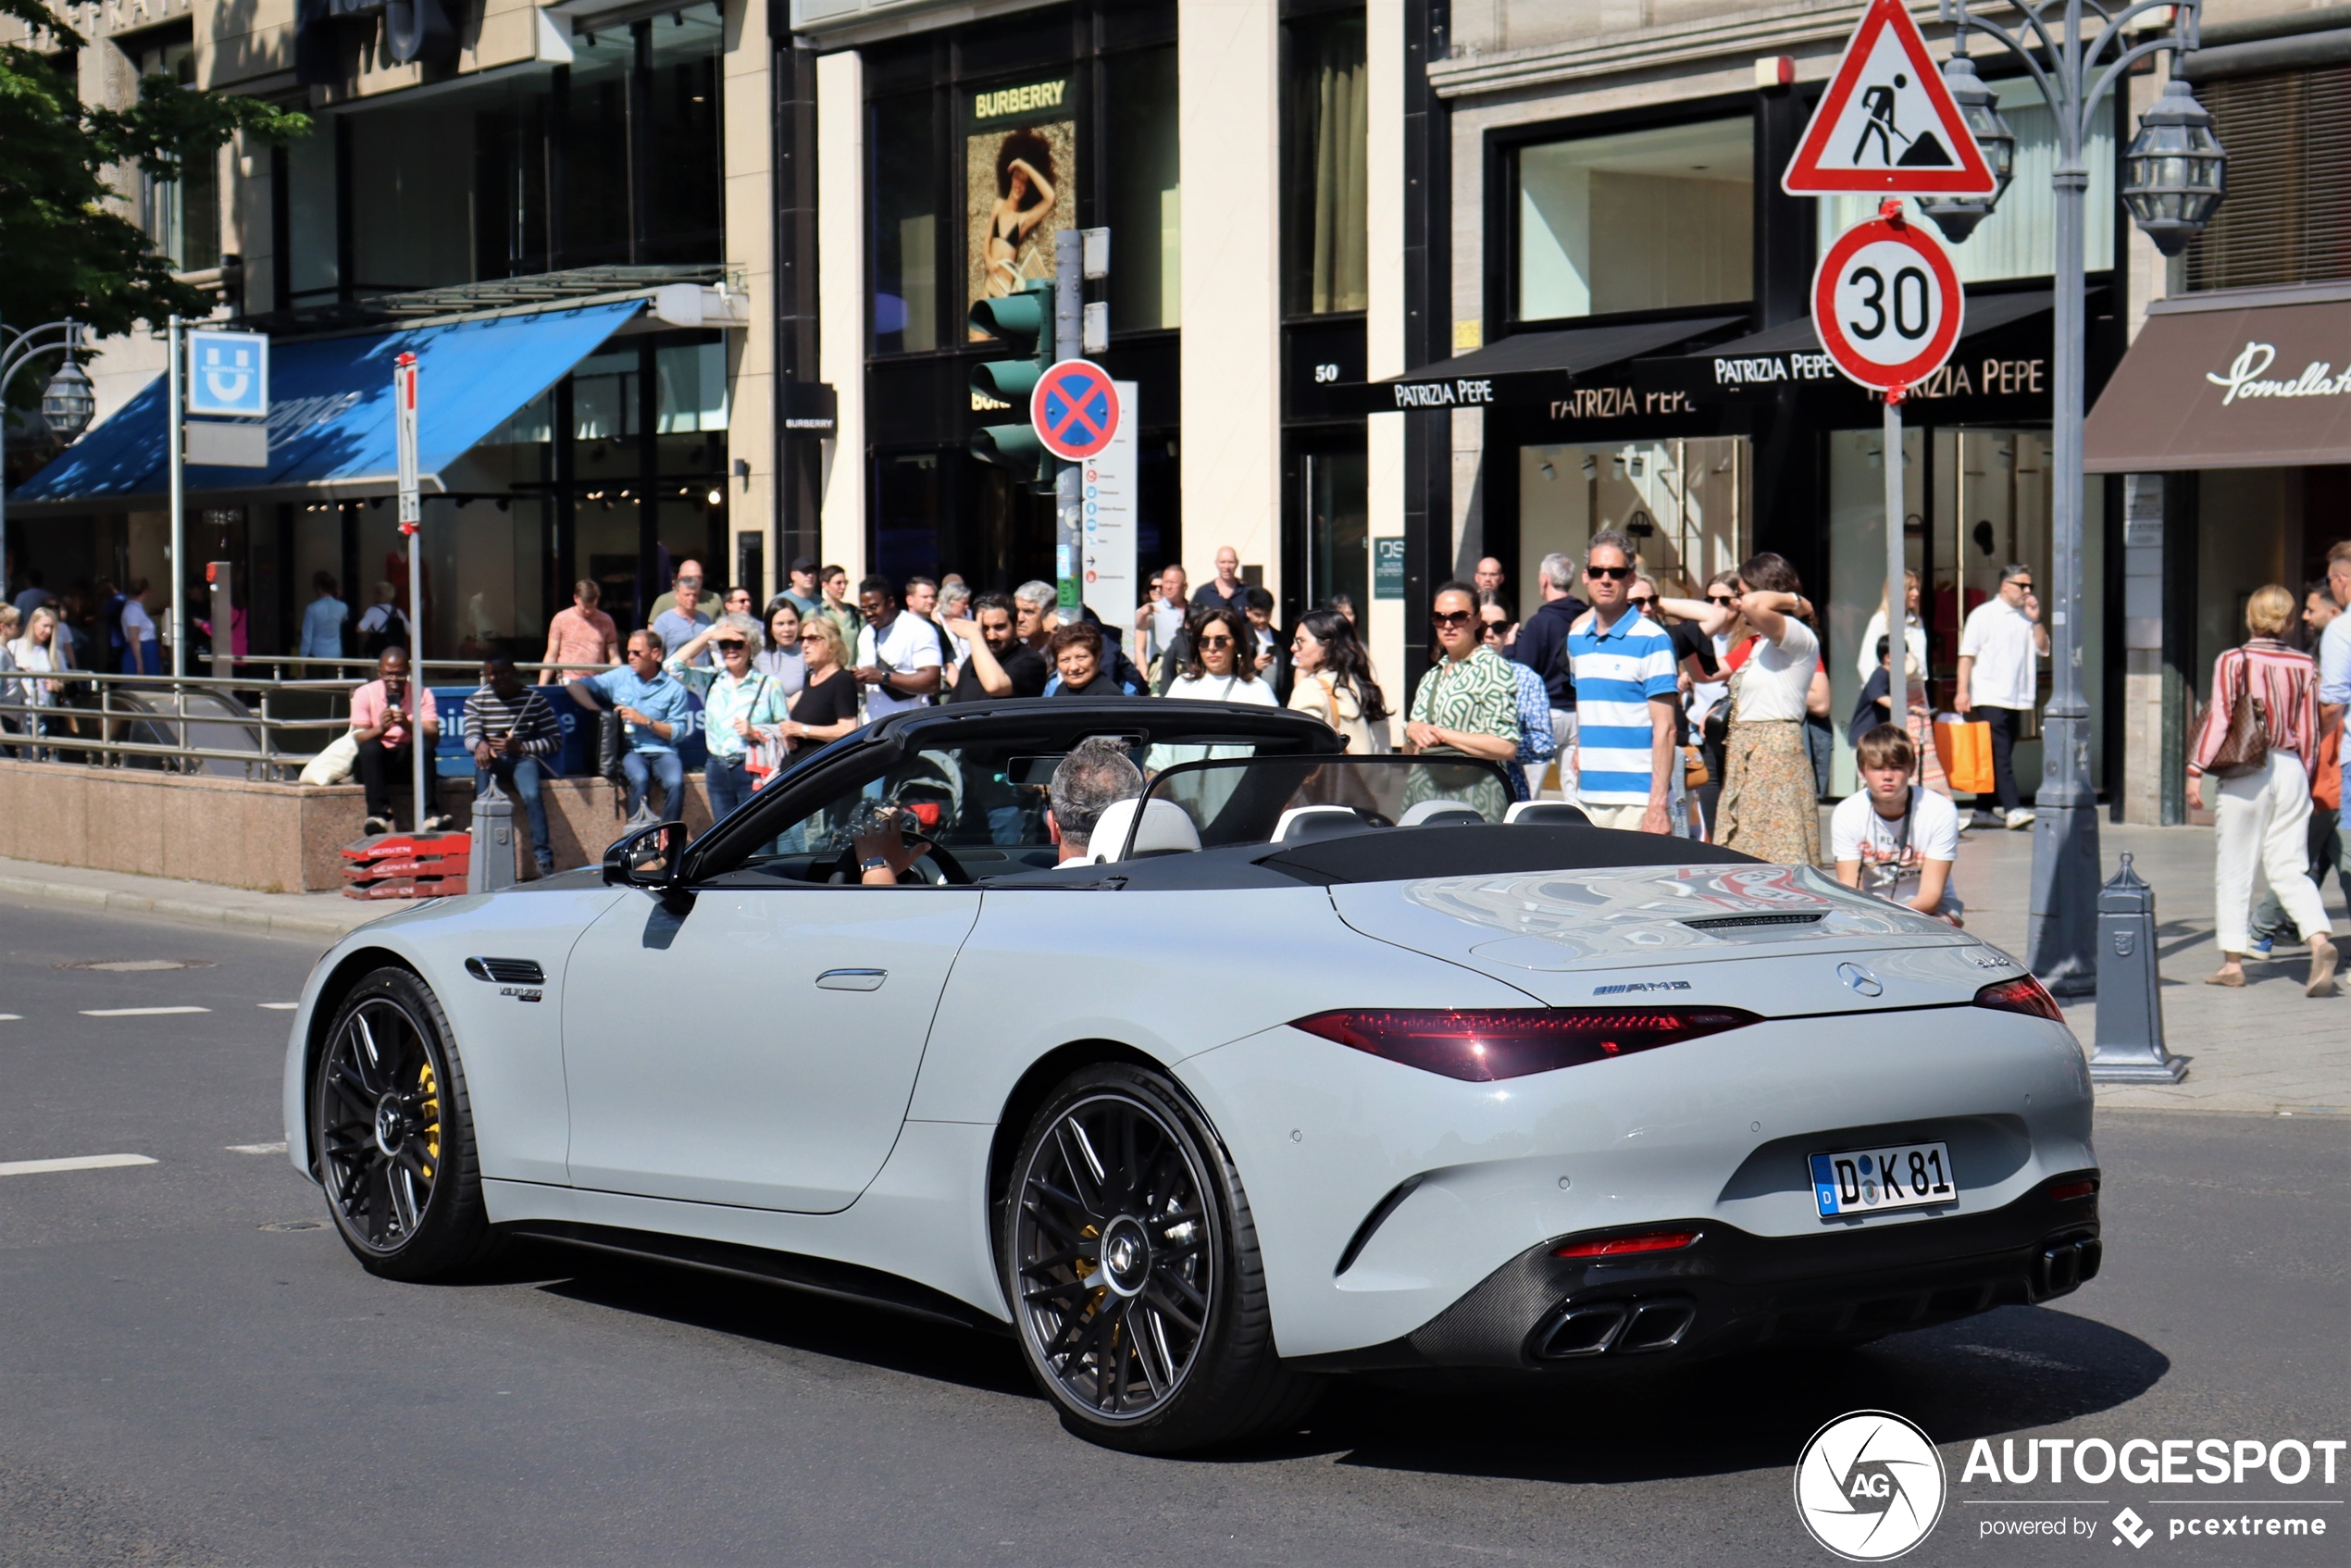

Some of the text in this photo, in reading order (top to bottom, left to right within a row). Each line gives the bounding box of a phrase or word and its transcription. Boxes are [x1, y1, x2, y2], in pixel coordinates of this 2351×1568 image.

[976, 80, 1065, 118] BURBERRY
[1849, 266, 1930, 341] 30
[1315, 364, 1339, 383] 50
[1714, 354, 1835, 385] PATRIZIA PEPE
[1983, 358, 2045, 395] PEPE
[1394, 380, 1494, 407] PATRIZIA PEPE
[785, 418, 834, 429] BURBERRY
[367, 846, 412, 856] GERKEN
[1880, 836, 1899, 846] REA
[1835, 1149, 1950, 1205] D K 81
[1822, 1191, 1832, 1205] D
